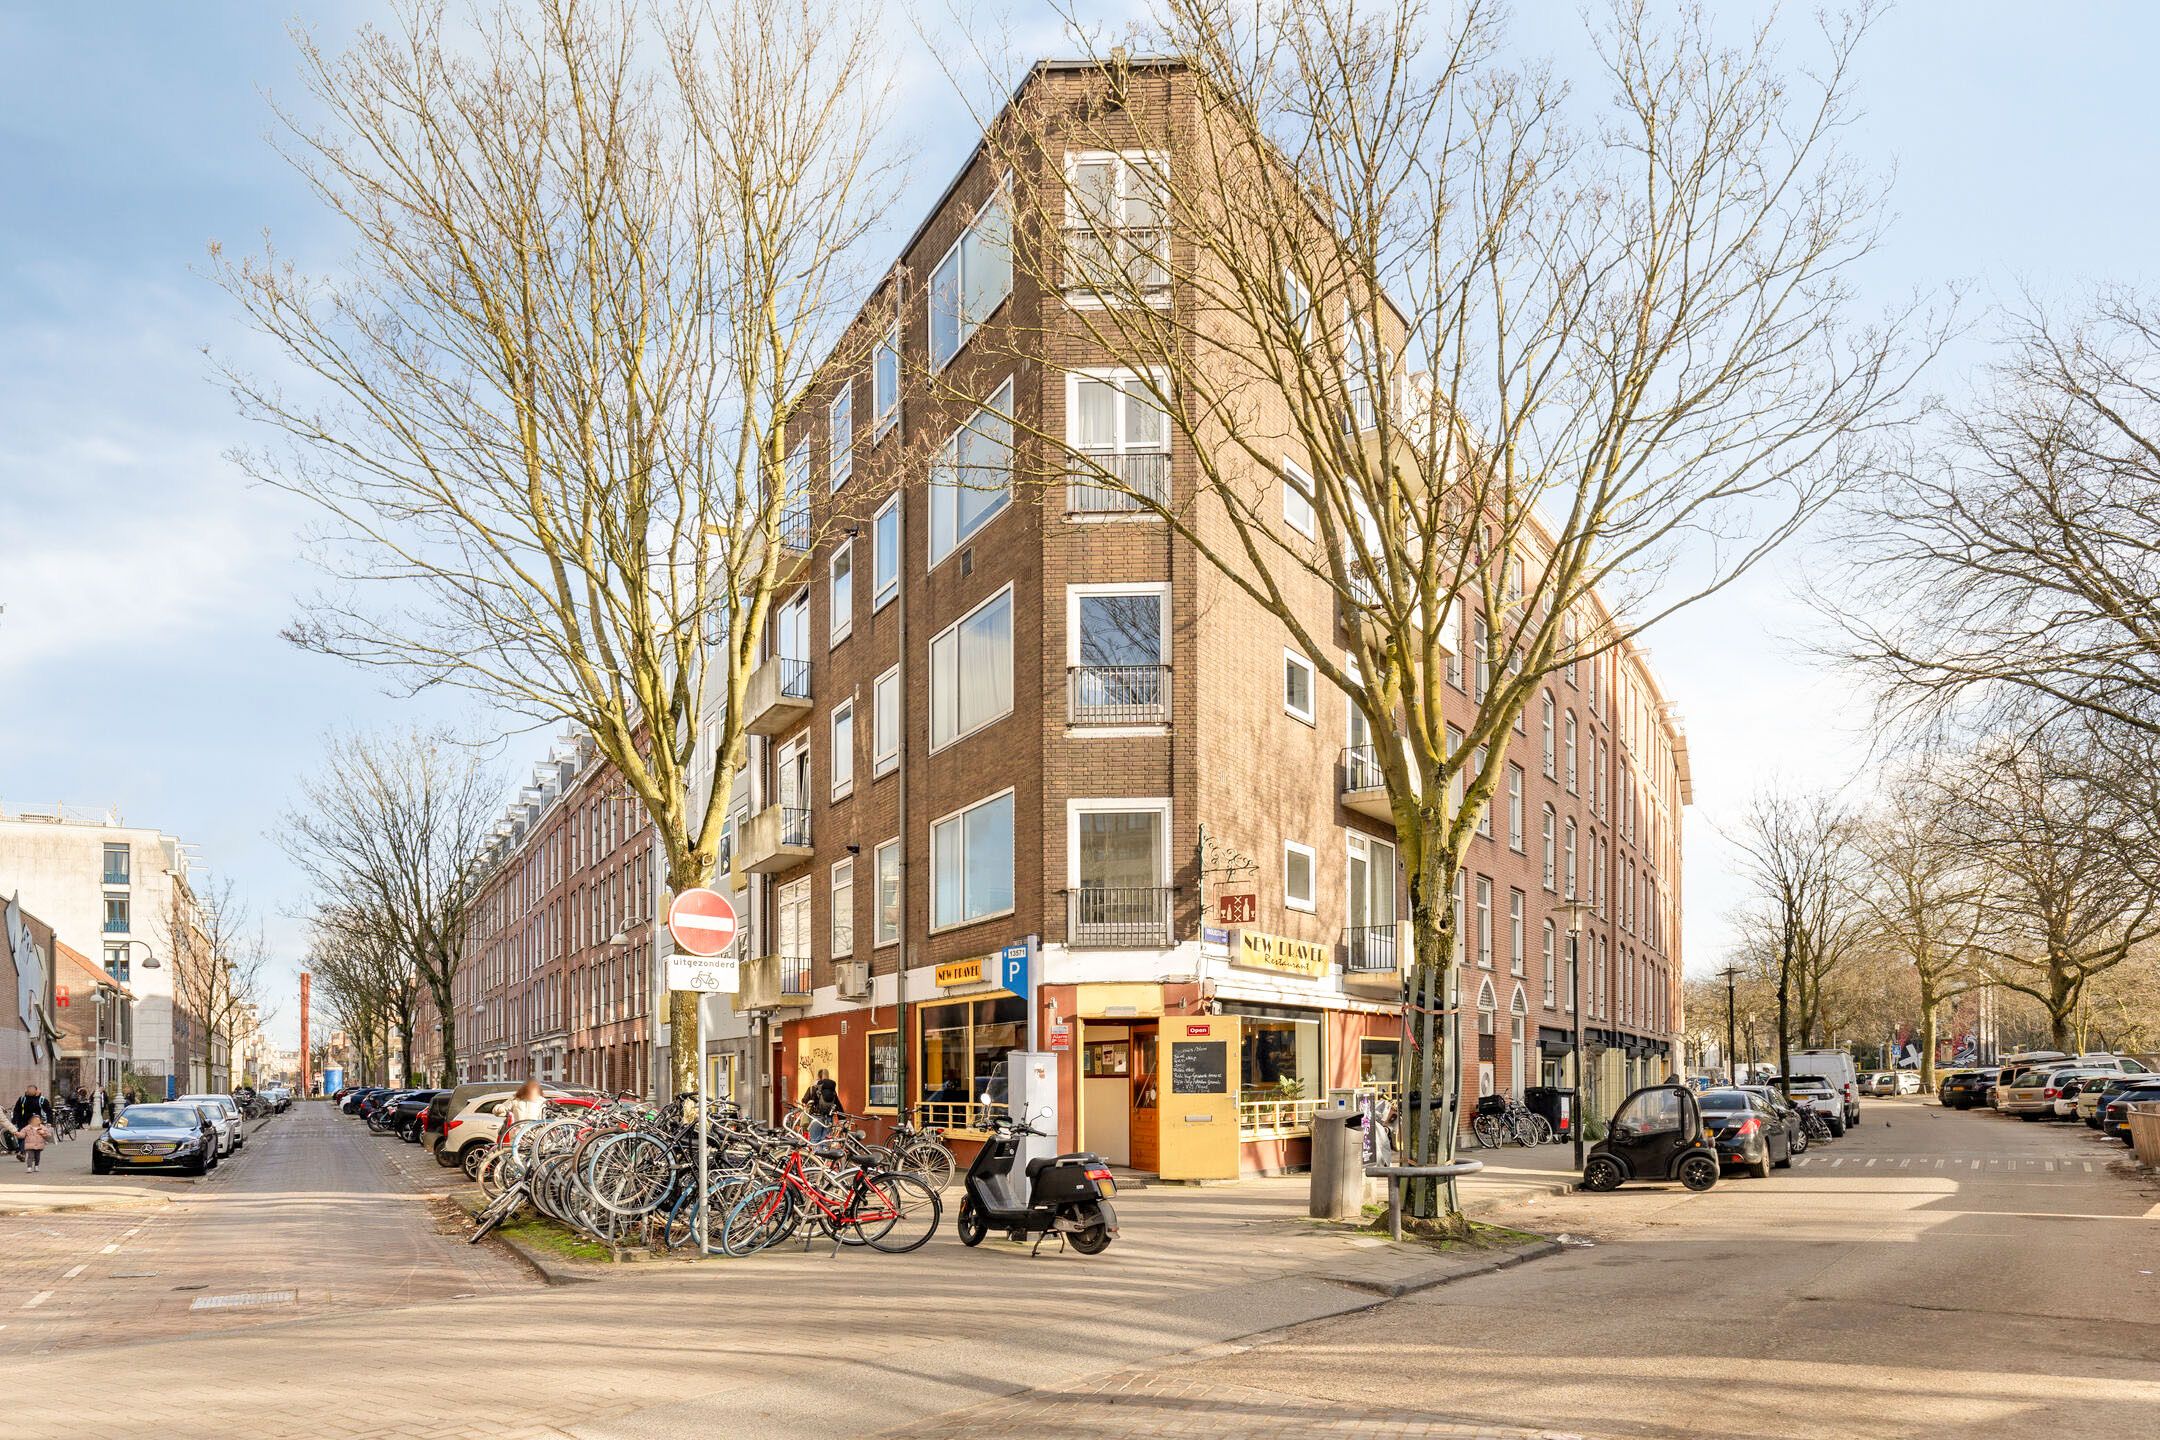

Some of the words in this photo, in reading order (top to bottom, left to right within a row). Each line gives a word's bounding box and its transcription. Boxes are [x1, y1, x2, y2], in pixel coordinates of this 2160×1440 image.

[1009, 948, 1025, 957] 13571
[1244, 935, 1272, 952] NEW
[1279, 941, 1325, 962] DRAVER
[673, 959, 735, 968] uitgezonderd
[1264, 953, 1309, 970] Restaurant
[938, 969, 952, 980] NEW
[954, 964, 979, 979] DRAVER
